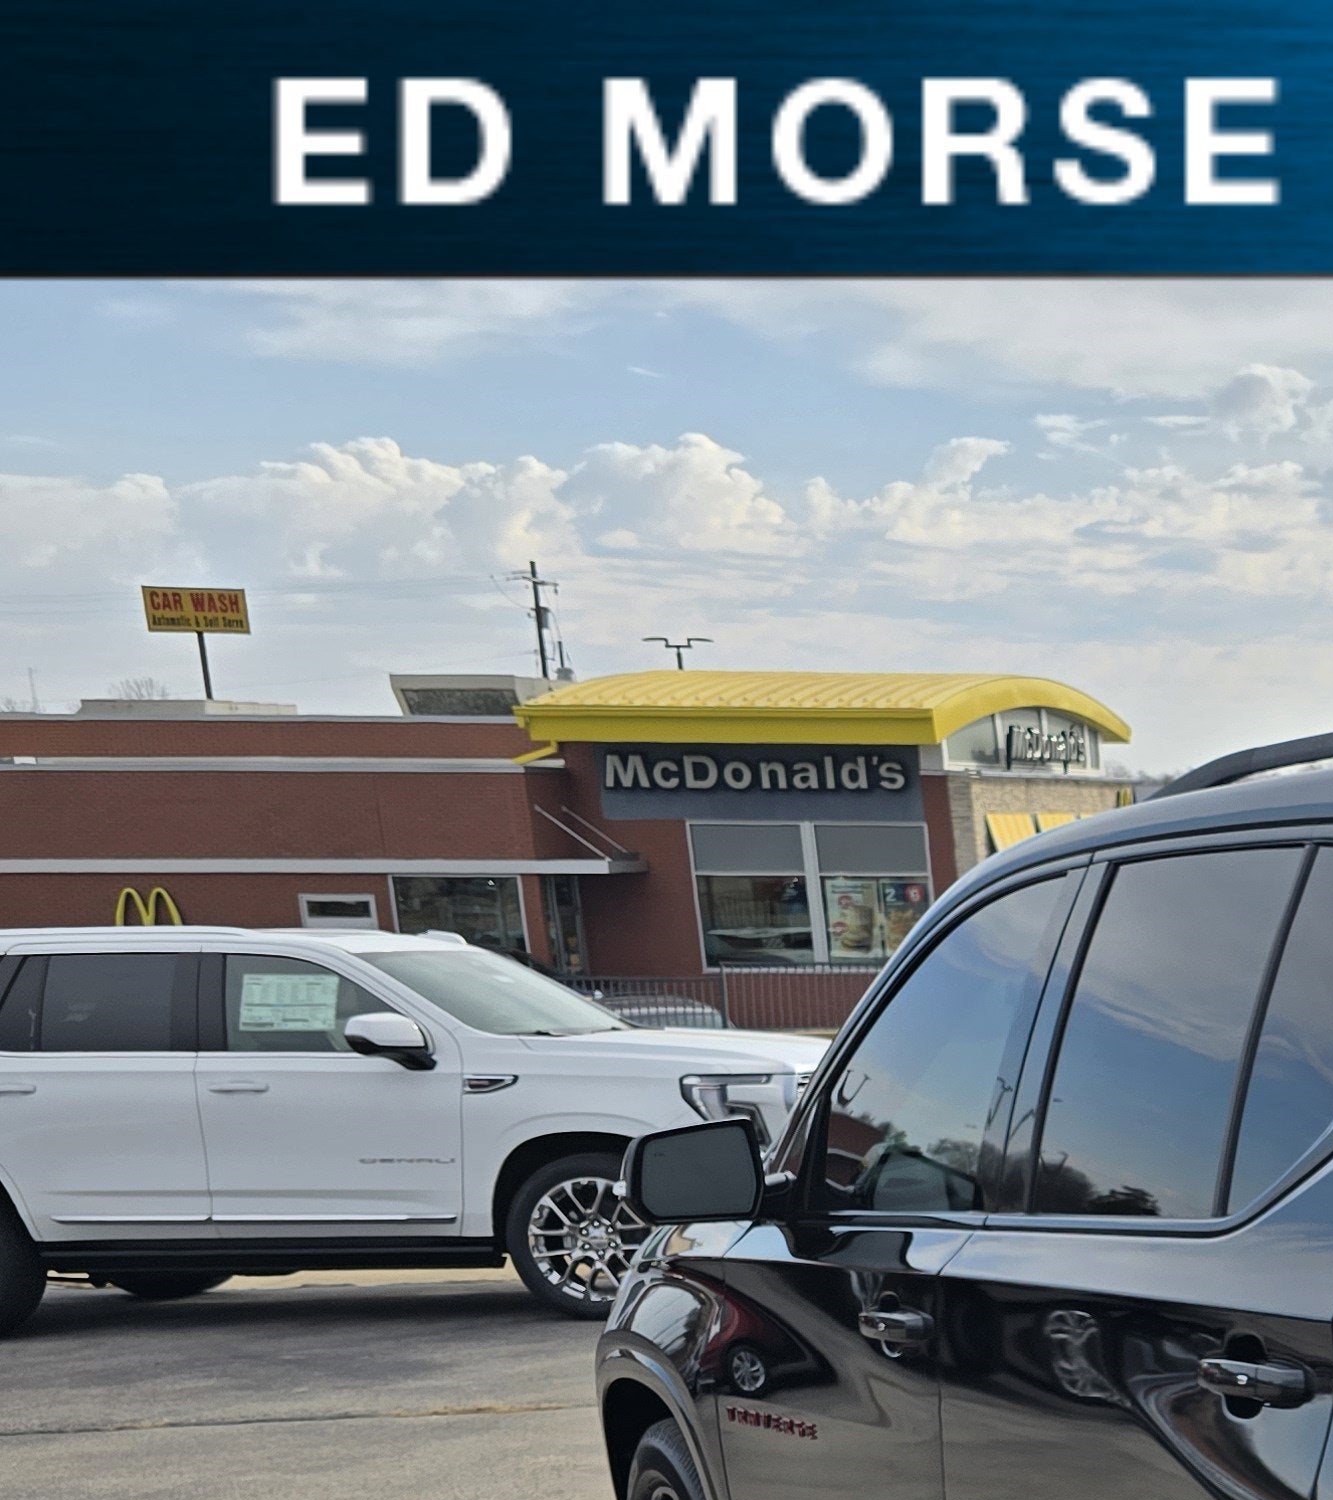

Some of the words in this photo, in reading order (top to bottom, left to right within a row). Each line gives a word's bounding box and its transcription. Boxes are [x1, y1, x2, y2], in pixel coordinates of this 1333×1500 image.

[149, 591, 184, 612] CAR
[190, 592, 240, 614] WASH
[152, 614, 192, 627] Automatic
[1007, 724, 1087, 768] McDonald's
[605, 754, 906, 791] McDonald's
